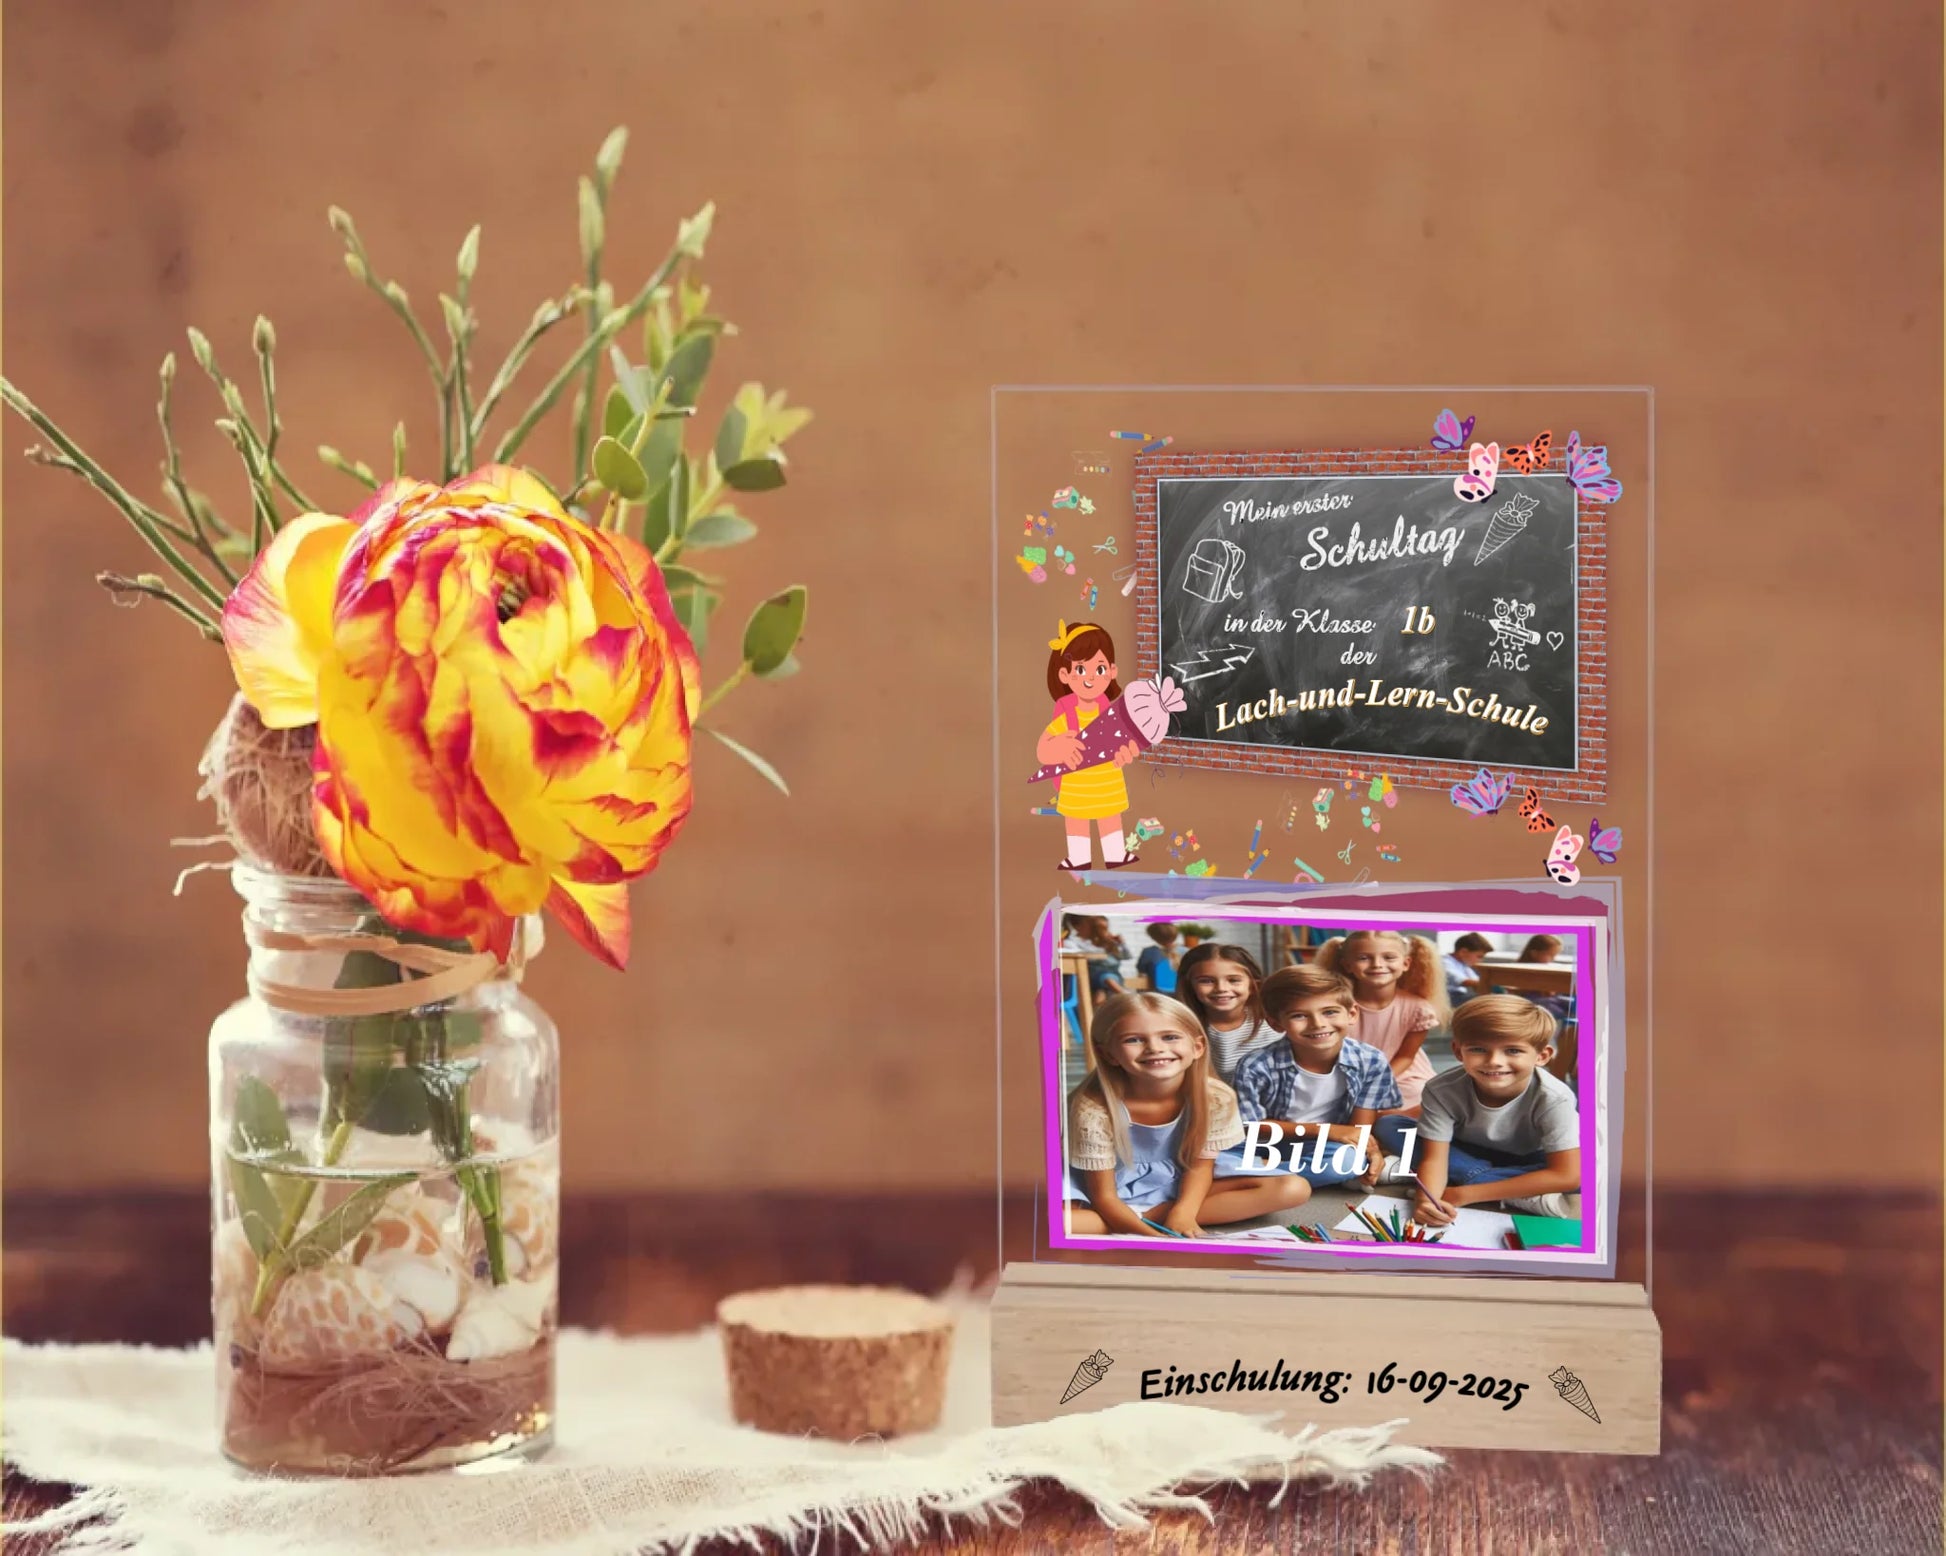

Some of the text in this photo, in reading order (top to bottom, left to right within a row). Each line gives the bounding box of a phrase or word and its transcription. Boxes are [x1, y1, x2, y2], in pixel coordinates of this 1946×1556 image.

[1223, 493, 1353, 526] Mein erster
[1300, 514, 1466, 571] Schultag
[1224, 605, 1437, 635] in der Klasse 1b
[1340, 641, 1378, 665] der
[1486, 650, 1531, 672] ABC
[1215, 678, 1549, 736] Lach-und-Lern-Schule
[1235, 1121, 1419, 1178] Bild 1
[1140, 1359, 1530, 1411] Einschulung: 16-09-2025
